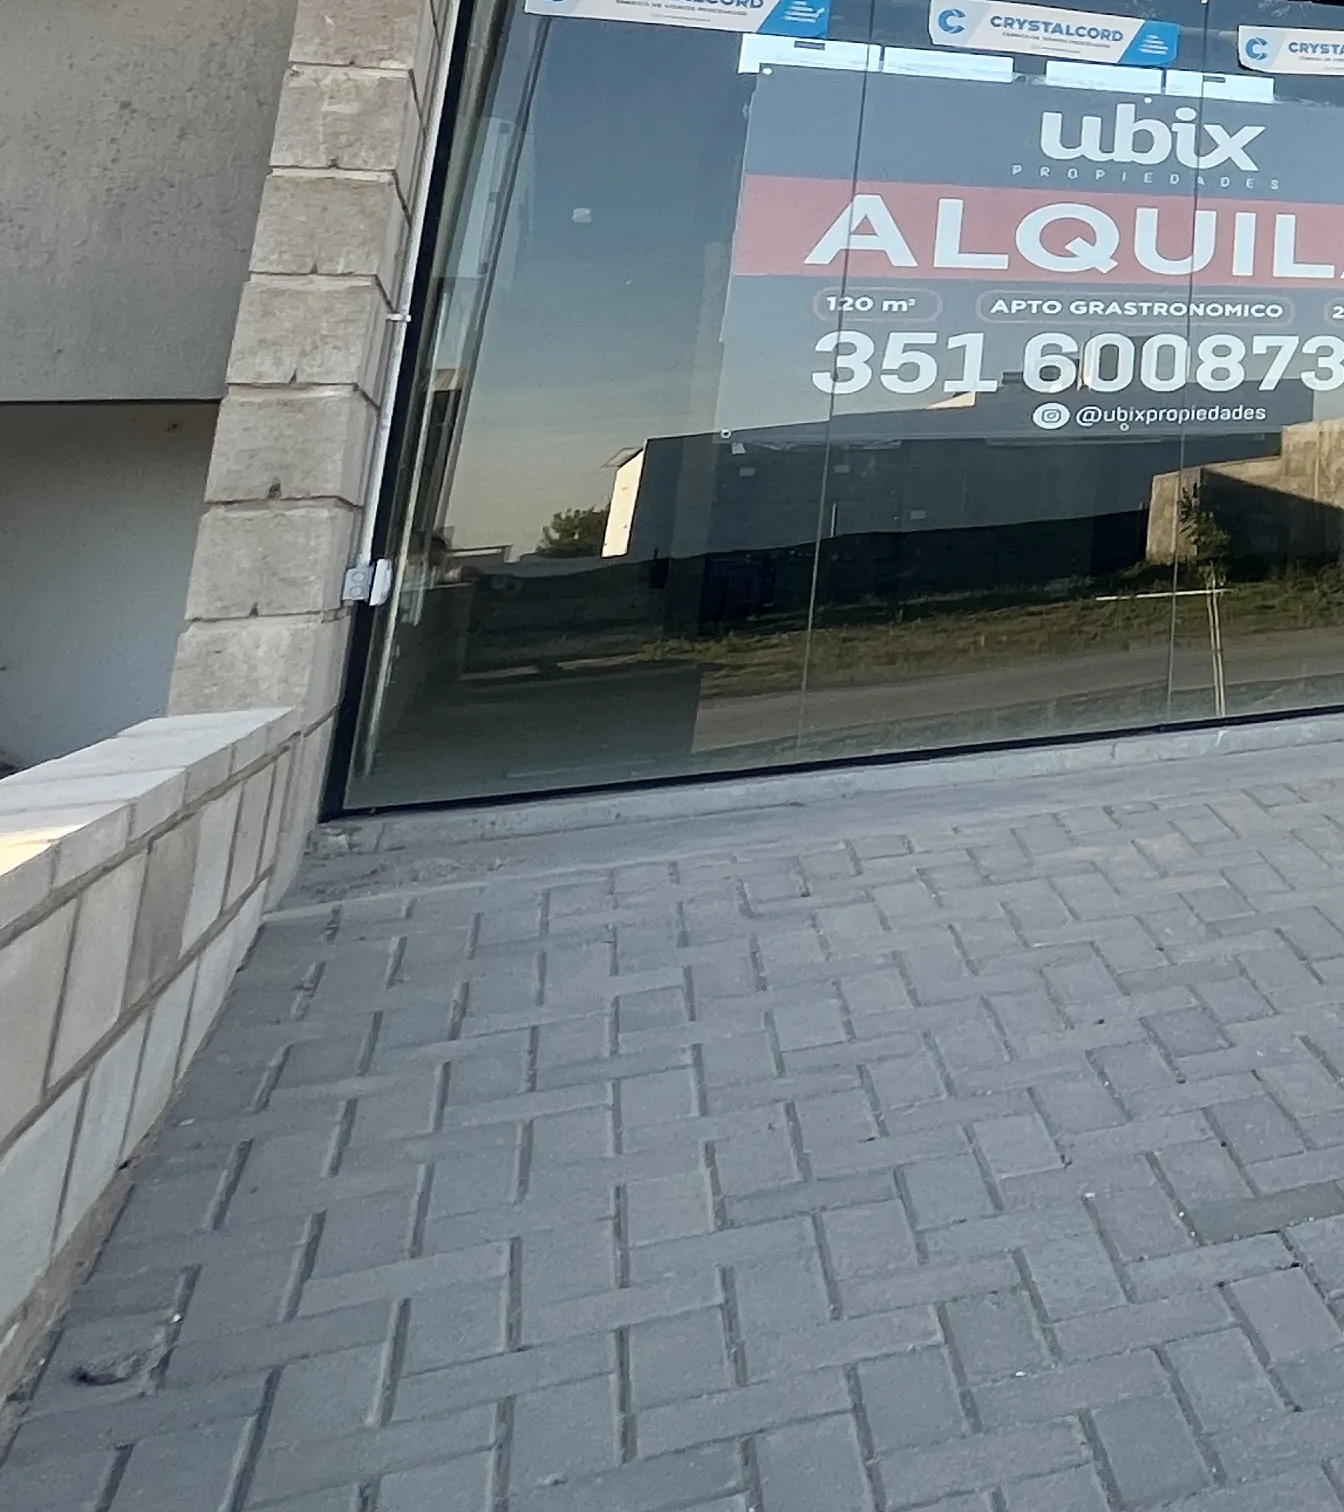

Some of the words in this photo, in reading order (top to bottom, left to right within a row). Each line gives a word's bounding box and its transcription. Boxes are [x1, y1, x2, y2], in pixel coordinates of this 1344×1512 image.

[990, 15, 1124, 42] CRYSTALCORD
[1040, 103, 1266, 171] ubix
[1012, 164, 1280, 189] PROPIEDADES
[826, 296, 875, 312] 120
[991, 299, 1062, 314] APTO
[1069, 300, 1284, 318] GRASTRONOMICO
[1332, 306, 1344, 319] 2
[811, 330, 999, 395] 351
[1076, 404, 1267, 427] @ubixpropiedades
